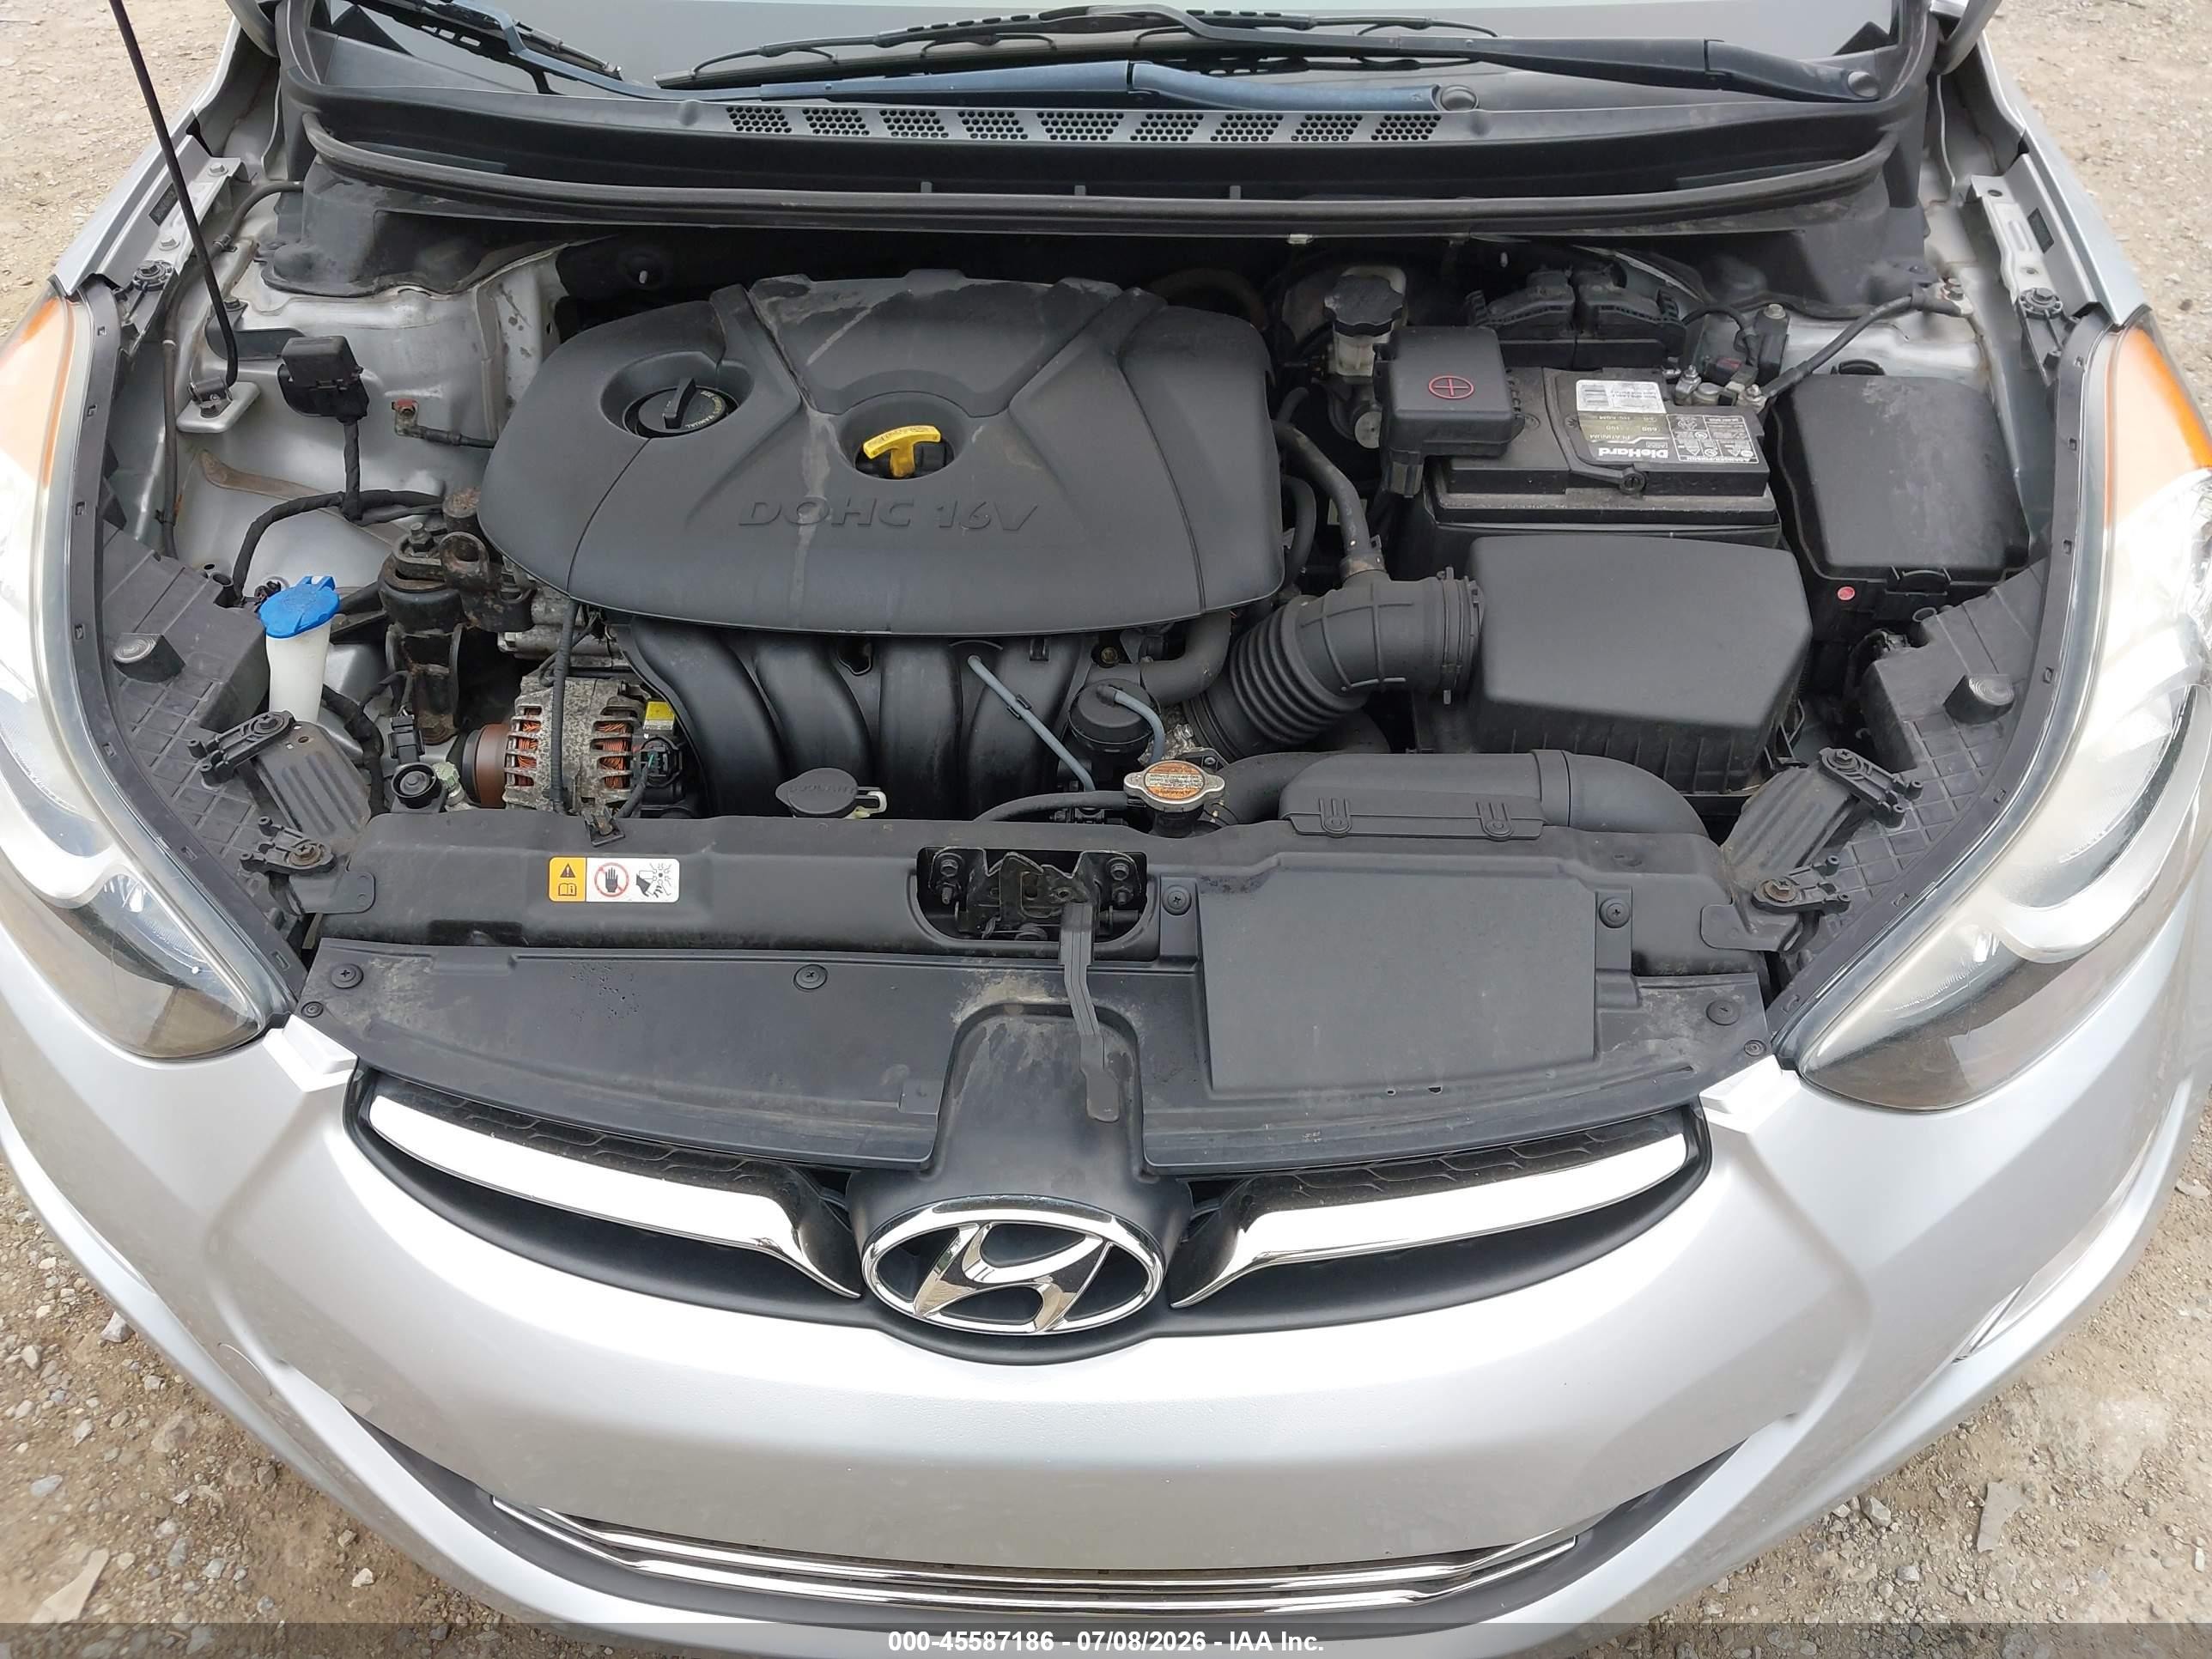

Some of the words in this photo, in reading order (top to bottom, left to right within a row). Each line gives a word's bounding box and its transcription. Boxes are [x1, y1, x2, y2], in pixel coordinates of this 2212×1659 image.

[1598, 447, 1668, 459] DieHard
[738, 496, 915, 527] DOHC
[936, 500, 1039, 532] 16V
